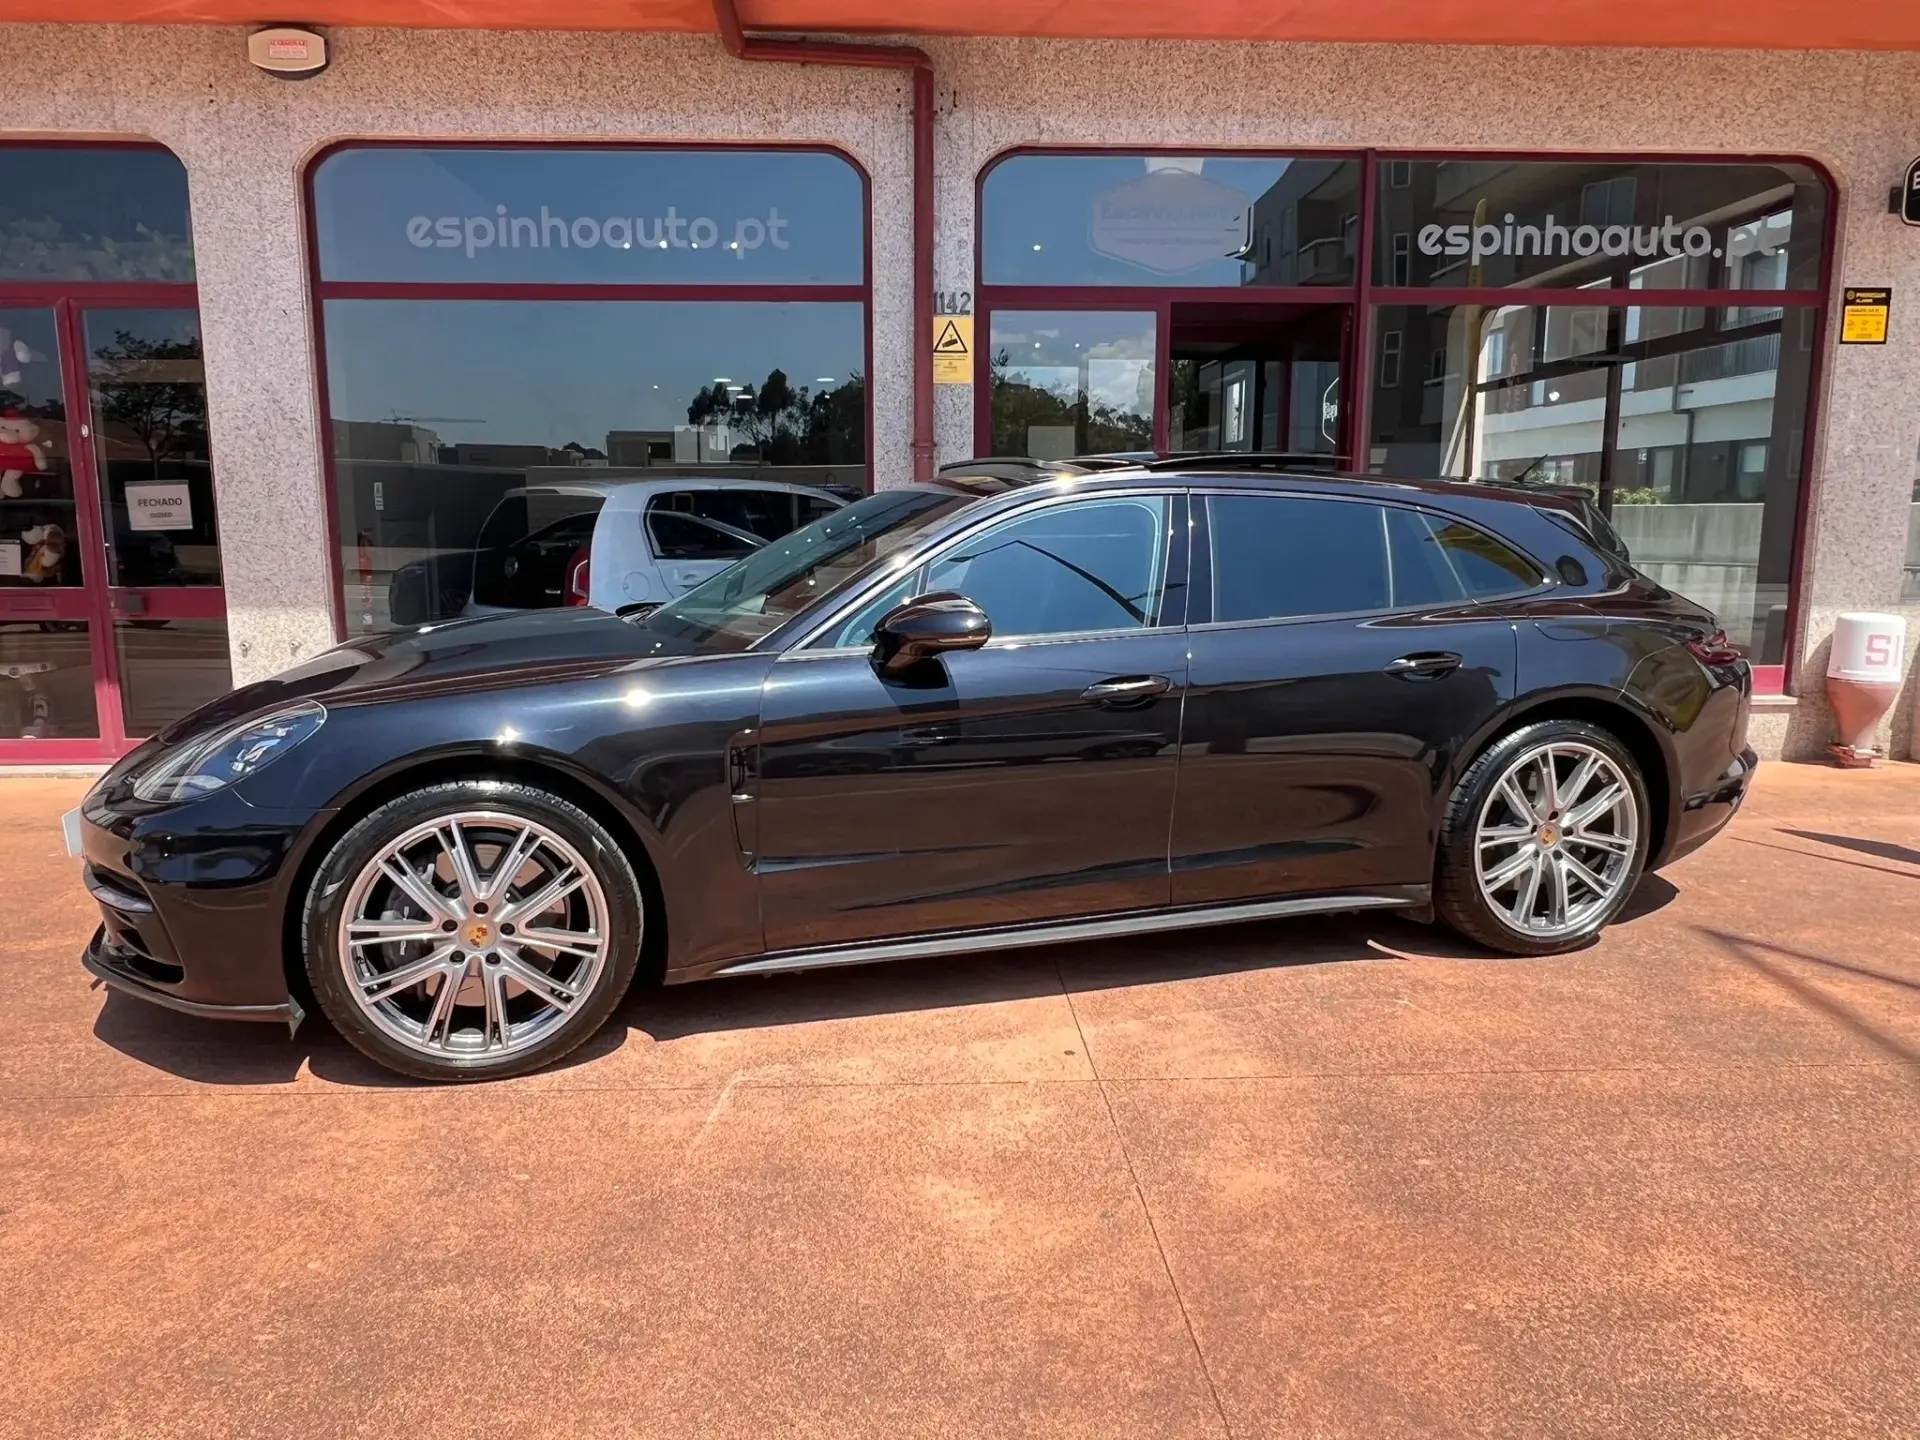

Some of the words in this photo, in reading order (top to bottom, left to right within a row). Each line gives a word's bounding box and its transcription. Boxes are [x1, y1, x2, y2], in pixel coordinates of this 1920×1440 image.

[406, 204, 789, 260] espinhoauto.pt
[1418, 213, 1778, 267] espinhoauto.pt
[137, 497, 183, 507] FECHADO
